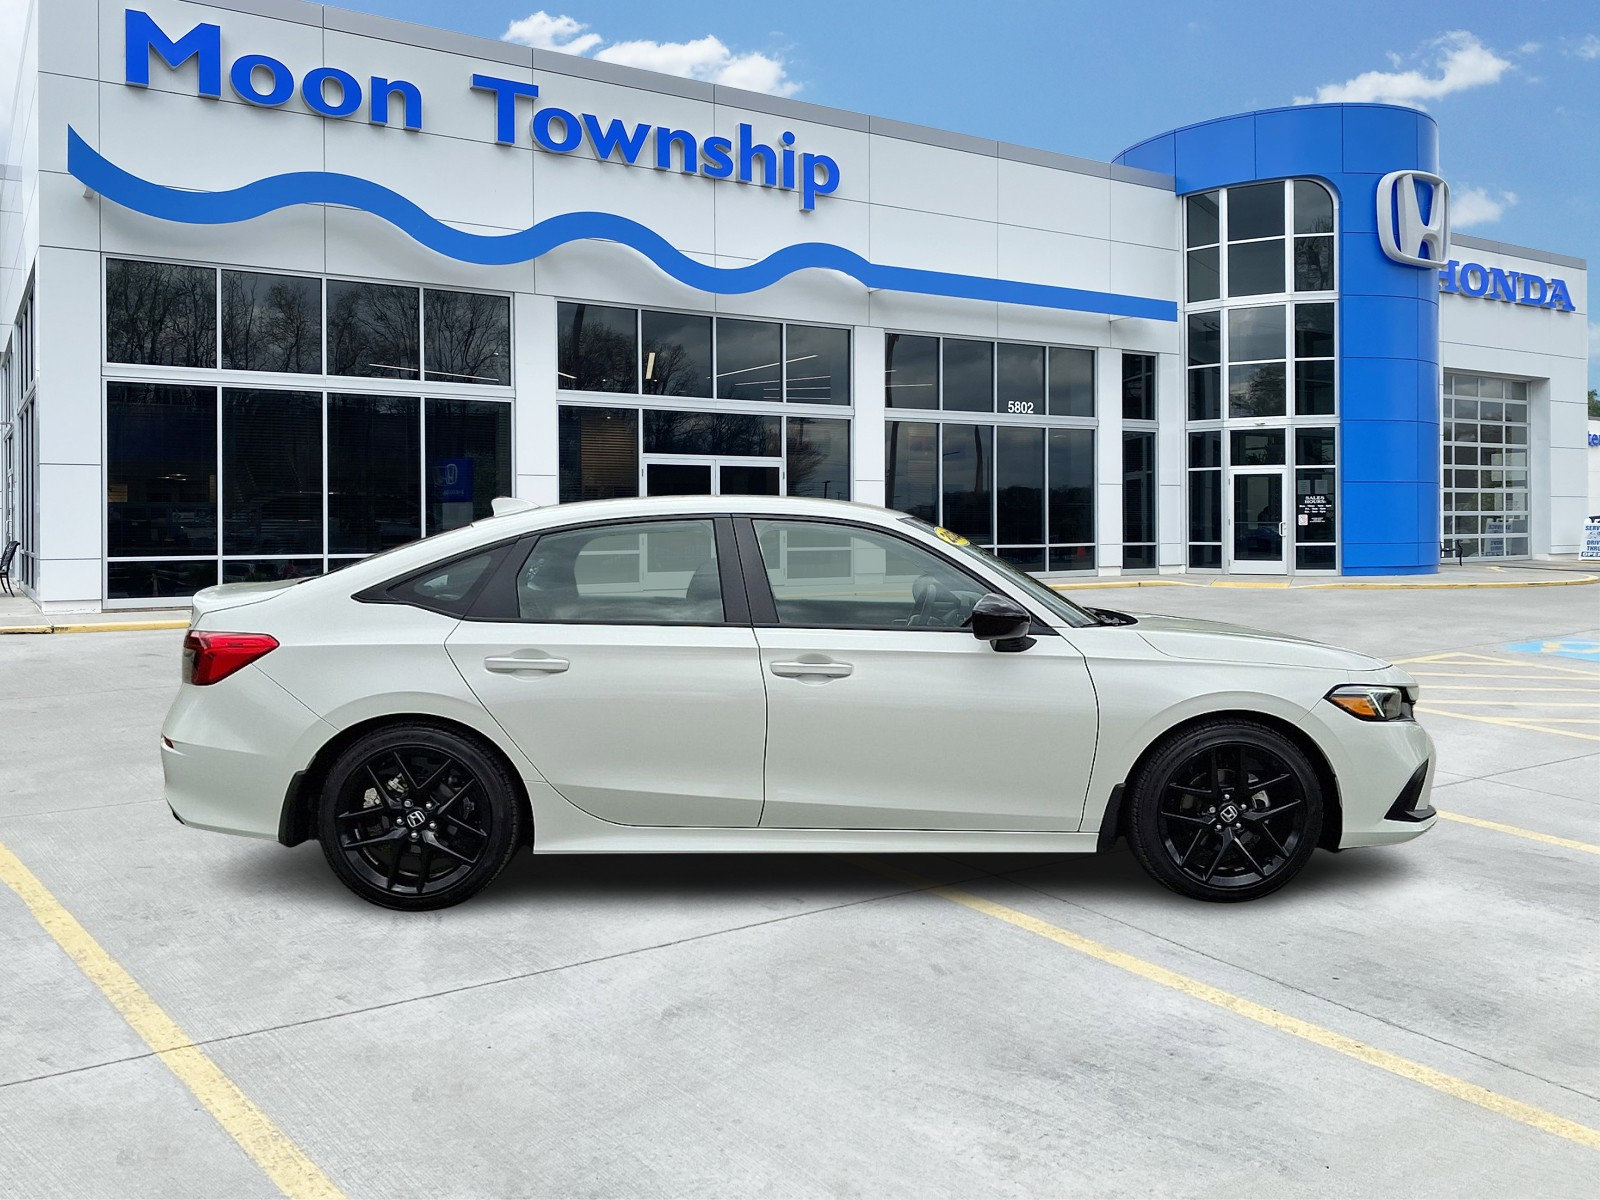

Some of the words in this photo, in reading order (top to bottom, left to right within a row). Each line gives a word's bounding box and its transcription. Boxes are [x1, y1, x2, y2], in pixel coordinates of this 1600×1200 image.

[124, 9, 422, 131] Moon
[469, 73, 841, 213] Township
[1438, 259, 1576, 312] HONDA
[1007, 400, 1034, 414] 5802
